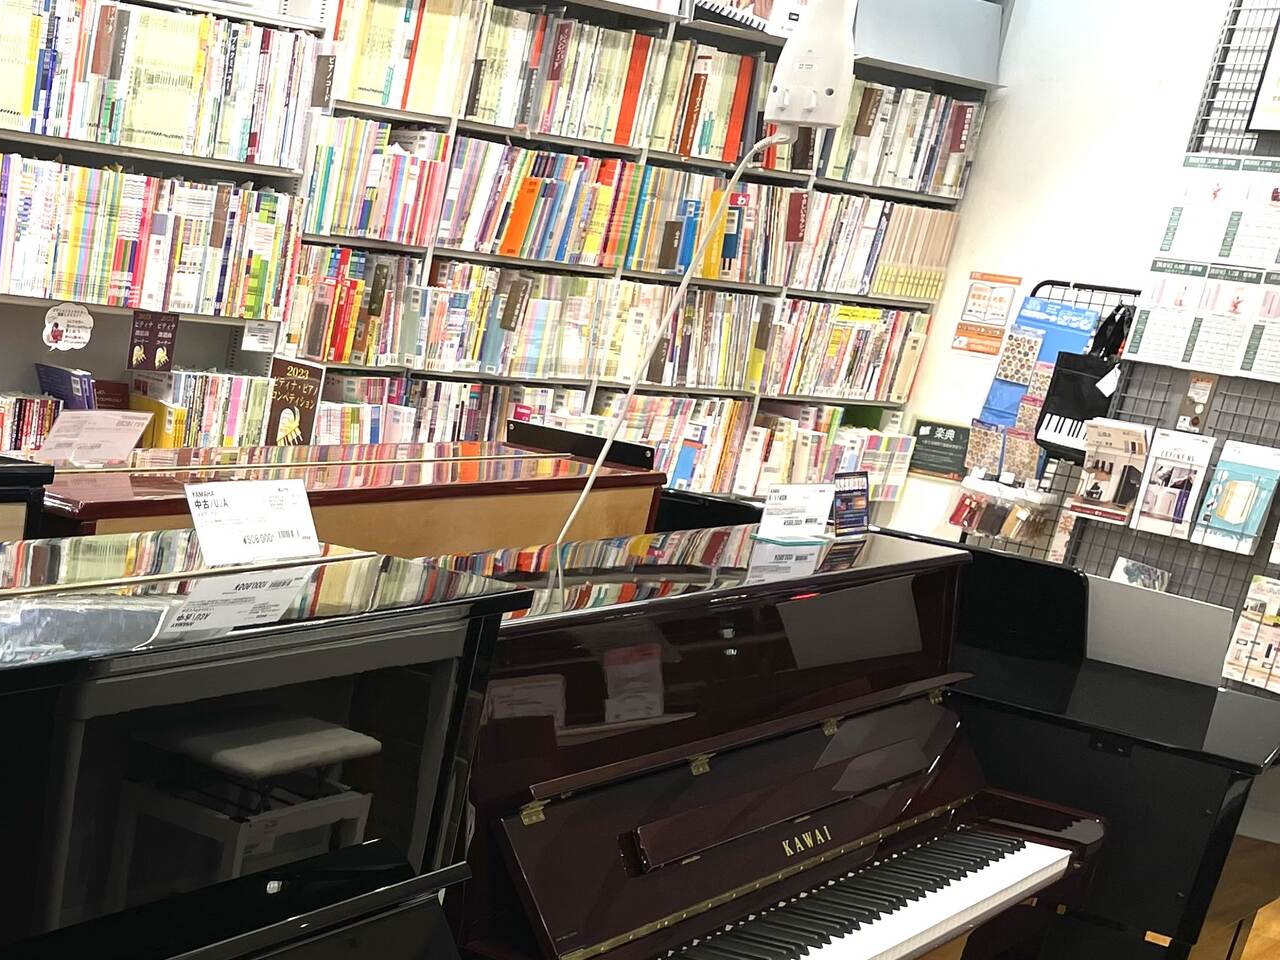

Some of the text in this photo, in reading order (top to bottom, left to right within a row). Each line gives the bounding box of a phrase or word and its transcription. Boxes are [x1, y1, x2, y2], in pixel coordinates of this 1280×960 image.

[324, 56, 336, 102] ピアノコード
[286, 365, 310, 380] 2023
[272, 390, 316, 409] コンペティション
[934, 426, 956, 441] 楽典
[782, 825, 833, 857] KAWAI
